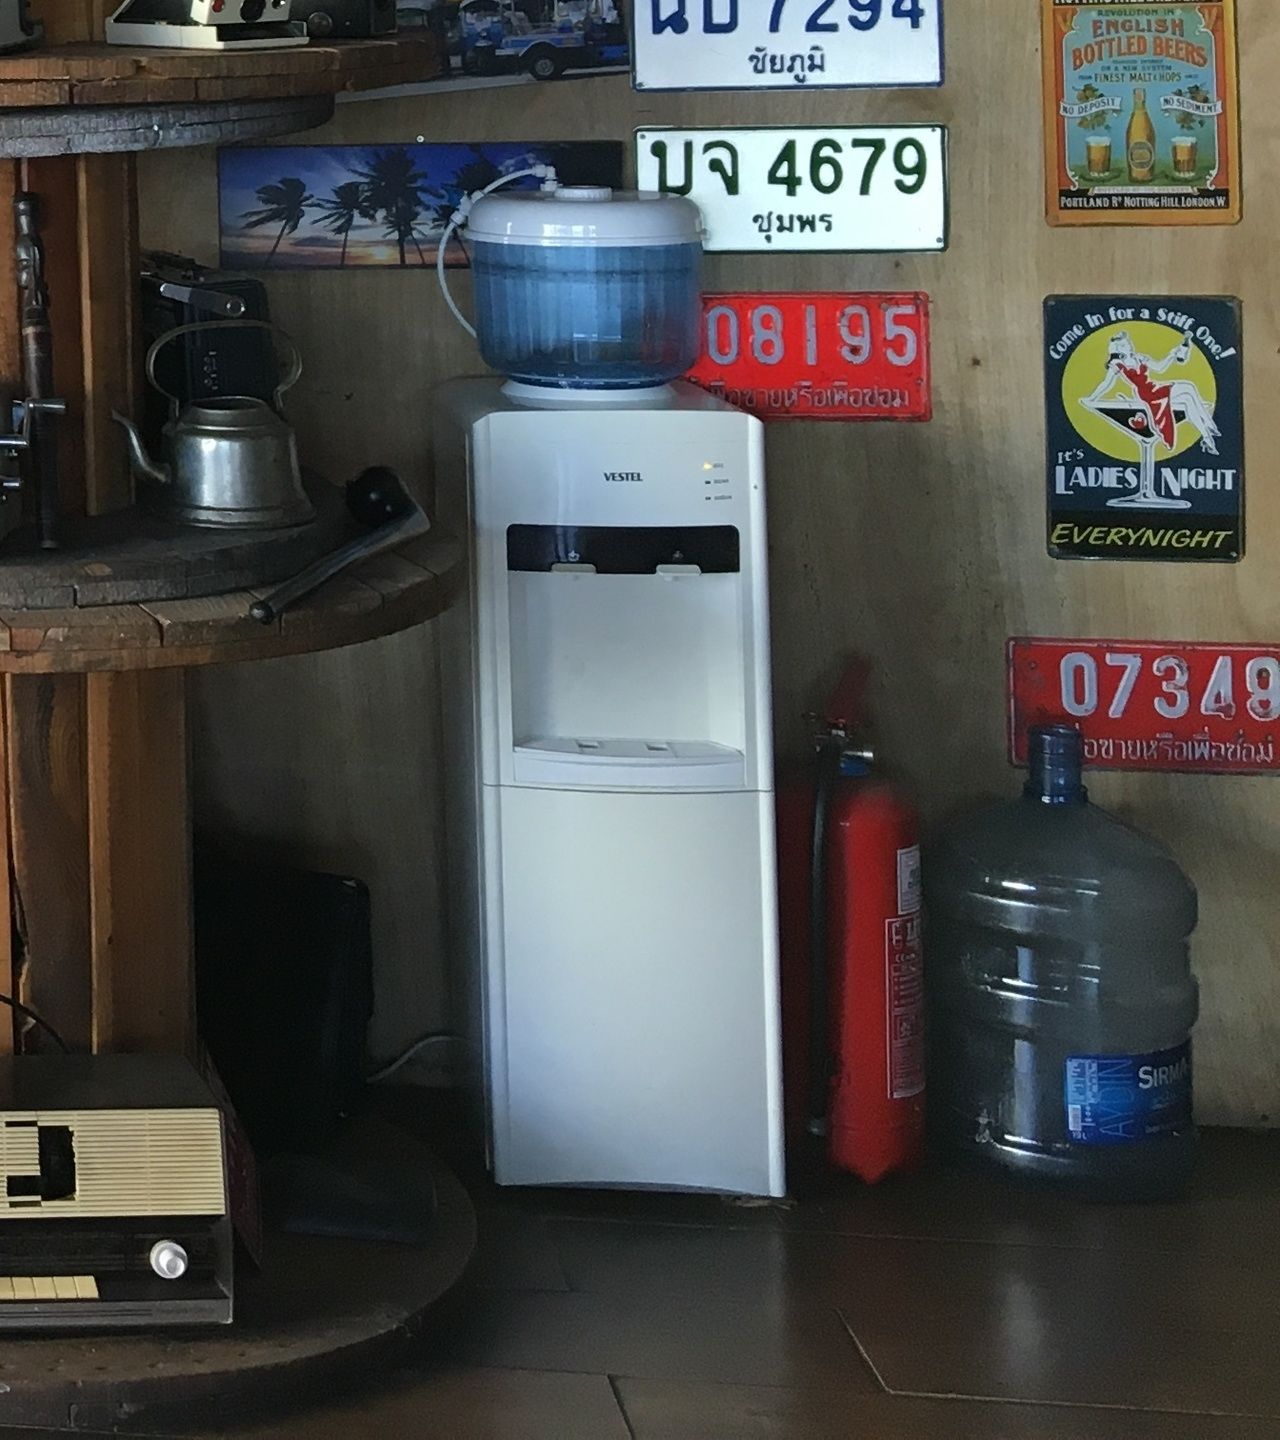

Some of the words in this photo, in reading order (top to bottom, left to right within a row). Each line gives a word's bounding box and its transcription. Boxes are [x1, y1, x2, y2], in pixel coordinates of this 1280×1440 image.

[1092, 18, 1184, 39] ENGLISH
[1072, 35, 1148, 71] BOTTLED
[1152, 35, 1208, 68] BEERS
[1094, 72, 1125, 83] FINEST
[1129, 72, 1152, 82] MALT
[767, 137, 928, 196] 4679
[1060, 195, 1109, 208] PORTLAND
[1124, 196, 1159, 207] NOTTING
[706, 304, 918, 366] 08195
[1049, 323, 1085, 360] Come
[1085, 313, 1105, 330] In
[1109, 306, 1135, 321] for
[1140, 308, 1150, 319] a
[1156, 308, 1195, 331] Stiff
[1196, 325, 1237, 361] One!
[604, 472, 643, 481] VESTEL
[1055, 465, 1138, 495] LADIES
[1160, 467, 1237, 497] NIGHT
[1050, 523, 1233, 549] EVERYNIGHT
